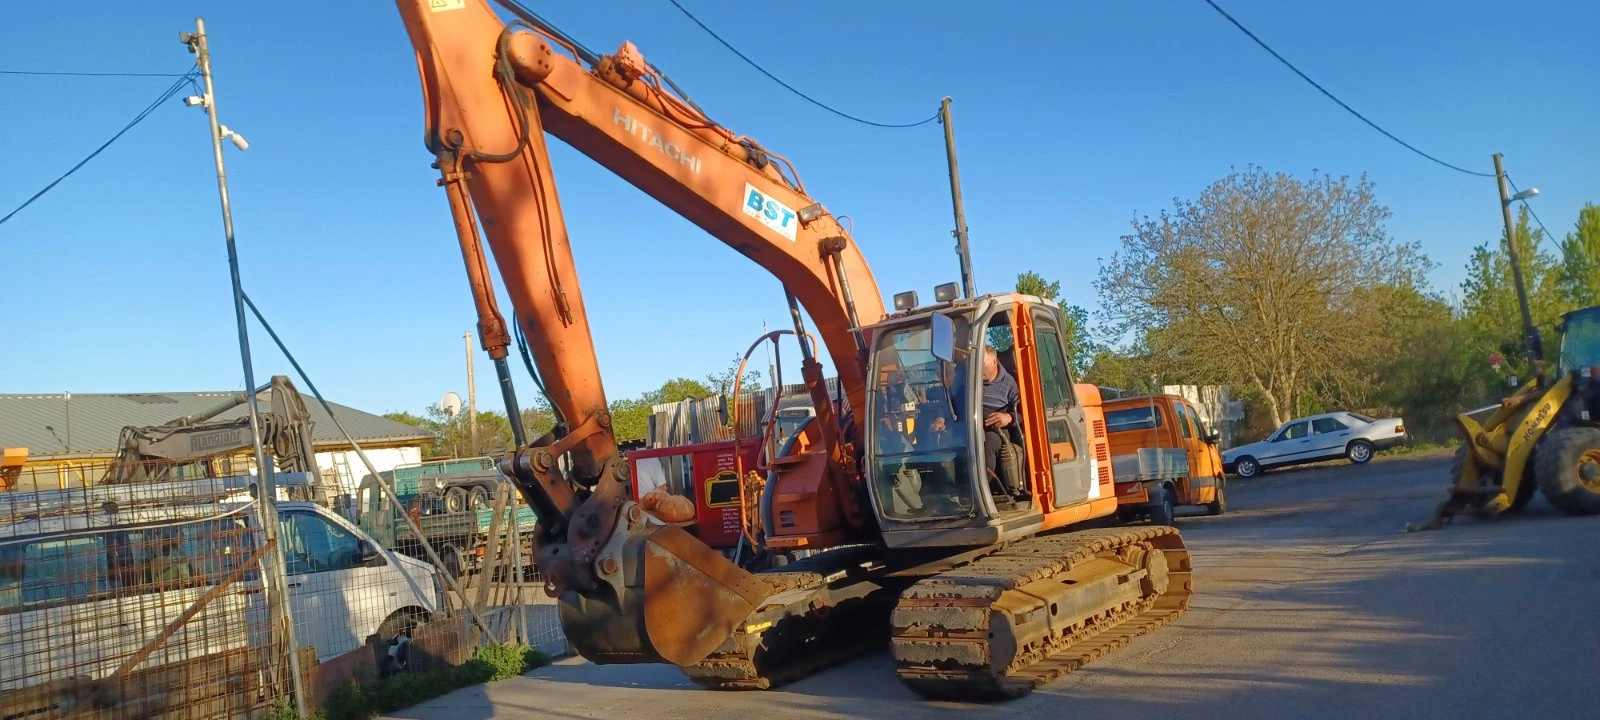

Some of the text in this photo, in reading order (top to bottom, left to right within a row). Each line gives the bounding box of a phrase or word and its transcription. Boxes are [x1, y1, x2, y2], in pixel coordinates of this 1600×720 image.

[613, 107, 702, 175] HITACHI
[747, 189, 795, 228] BST
[1523, 402, 1551, 442] KOMATSU
